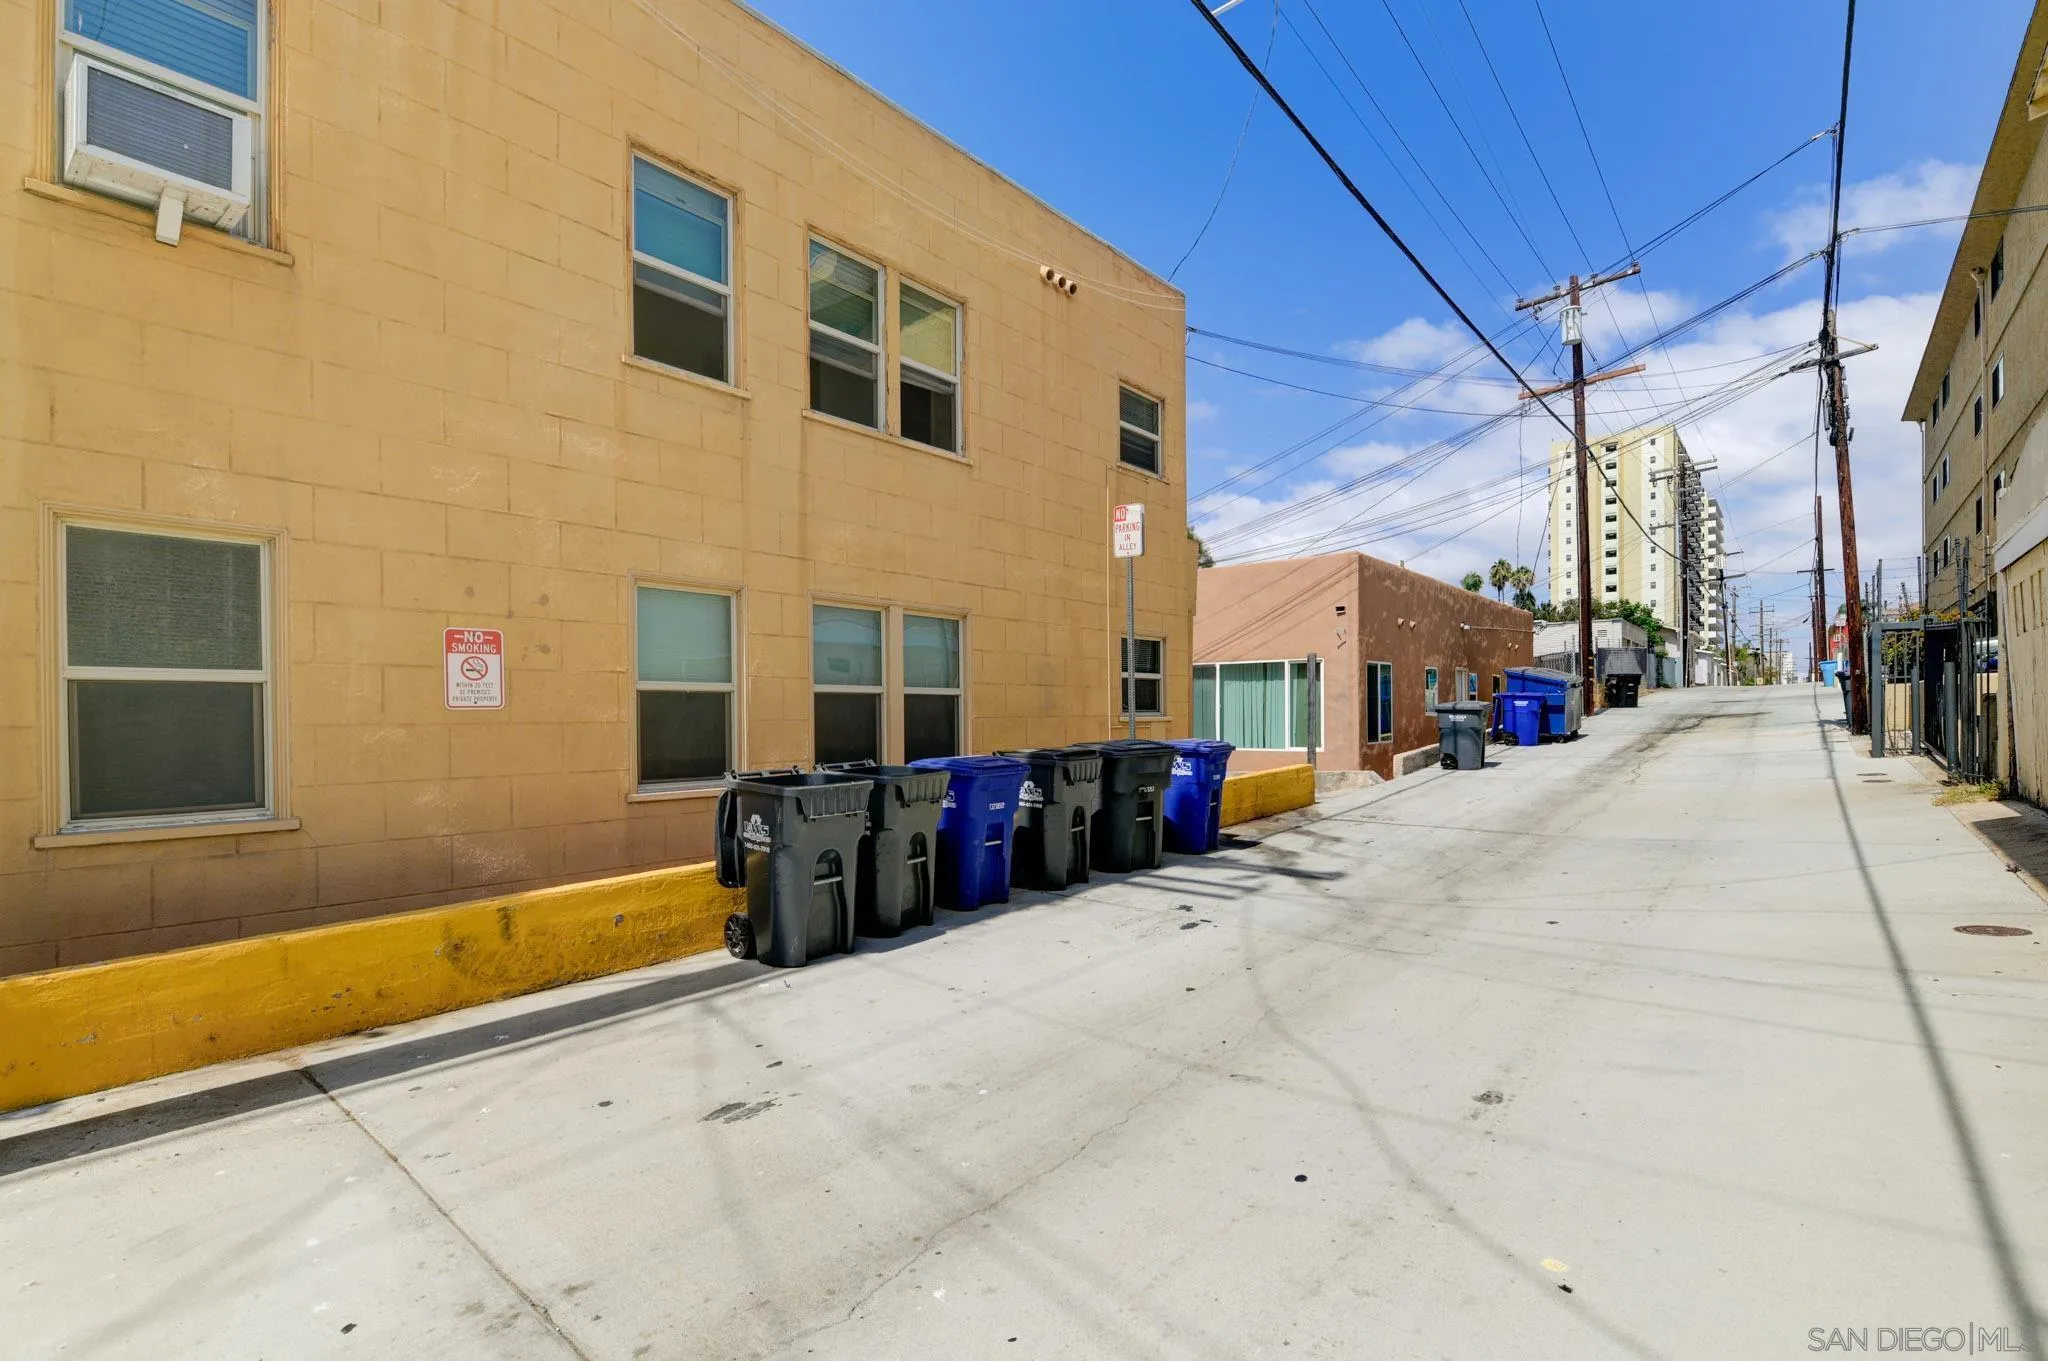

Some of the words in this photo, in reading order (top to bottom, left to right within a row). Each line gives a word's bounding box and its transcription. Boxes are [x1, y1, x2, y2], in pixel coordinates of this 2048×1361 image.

[1115, 507, 1126, 521] NO
[1115, 521, 1140, 533] PARKING
[1124, 534, 1131, 542] IN
[1119, 542, 1137, 551] ALLEY
[463, 631, 483, 643] NO
[451, 642, 497, 654] SMOKING
